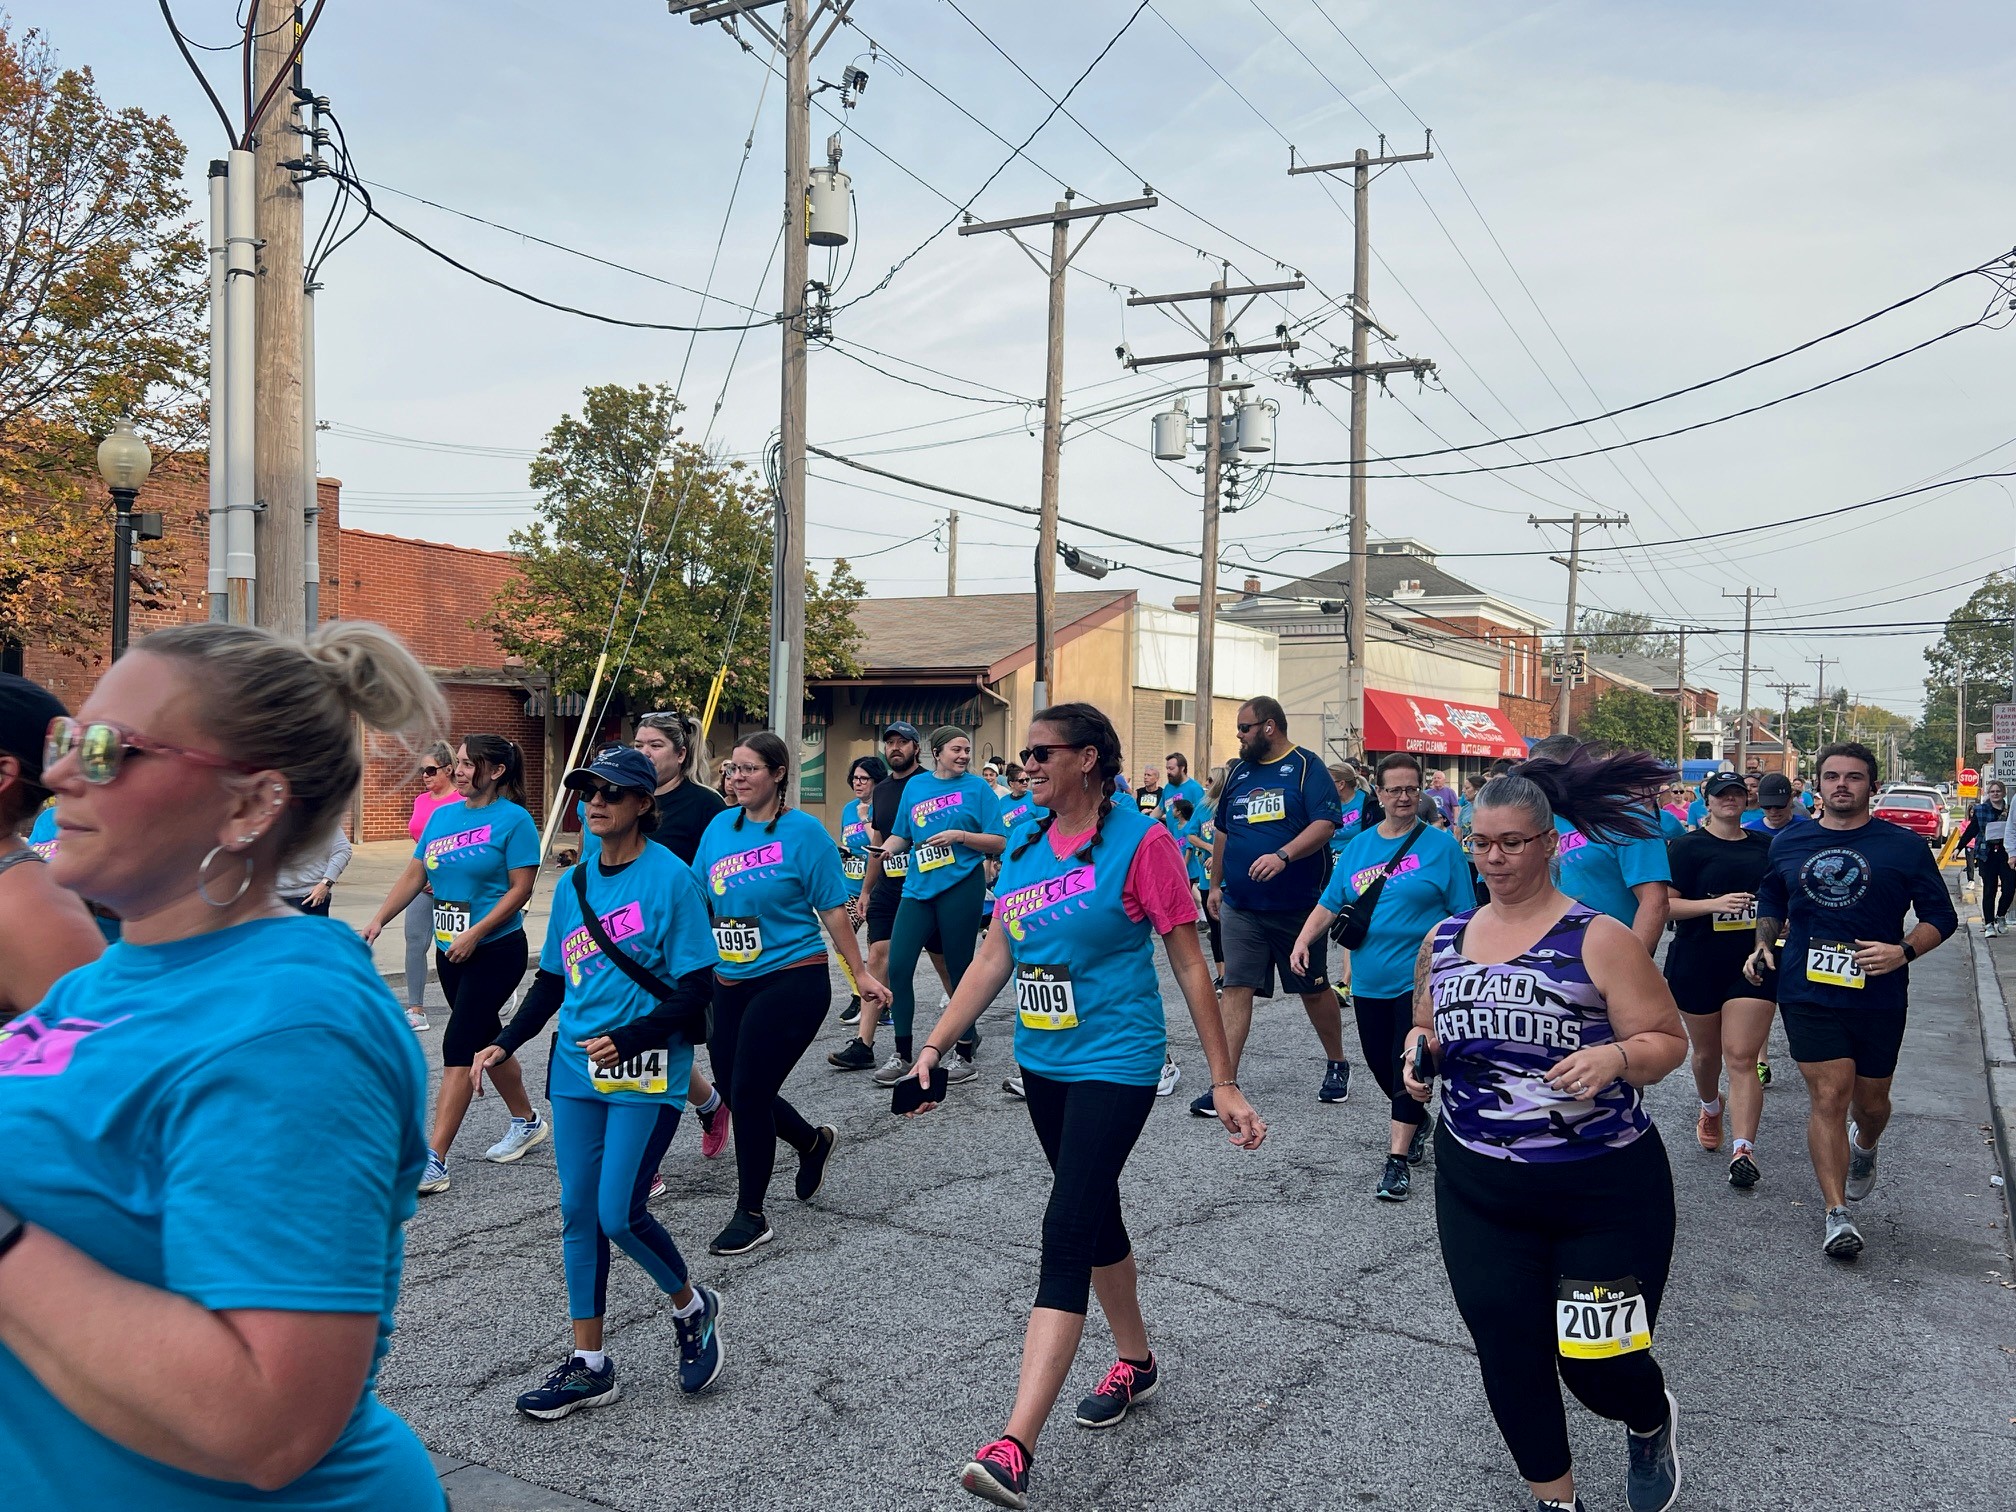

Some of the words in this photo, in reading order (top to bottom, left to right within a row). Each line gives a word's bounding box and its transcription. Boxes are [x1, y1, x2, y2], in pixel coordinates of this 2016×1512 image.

[1406, 739, 1425, 751] CARPET
[1426, 740, 1448, 753] CLEANING
[1461, 743, 1472, 754] DUCT
[1473, 744, 1491, 756] CLEANING
[1960, 774, 1978, 782] STOP
[1250, 797, 1280, 816] 1766
[429, 836, 457, 849] CHILI
[457, 829, 485, 846] 5K
[425, 844, 454, 858] CHASE
[715, 855, 744, 873] CHILI
[743, 844, 777, 868] 5K
[920, 846, 950, 864] 1996
[843, 861, 863, 874] 2076
[886, 855, 908, 870] 1981
[711, 864, 743, 882] CHASE
[1005, 885, 1044, 907] CHILI
[1044, 869, 1088, 903] 5K
[1002, 897, 1043, 923] CHASE
[435, 912, 465, 932] 2003
[565, 930, 588, 952] CHIL
[717, 930, 757, 951] 1995
[566, 940, 598, 967] CHASE
[1812, 952, 1862, 977] 2179
[1022, 971, 1035, 979] final
[1019, 982, 1068, 1013] 2009
[1439, 974, 1536, 1007] ROAD
[1434, 1007, 1582, 1051] ARRIORS
[1573, 1290, 1594, 1301] final
[1563, 1300, 1638, 1340] 2077
